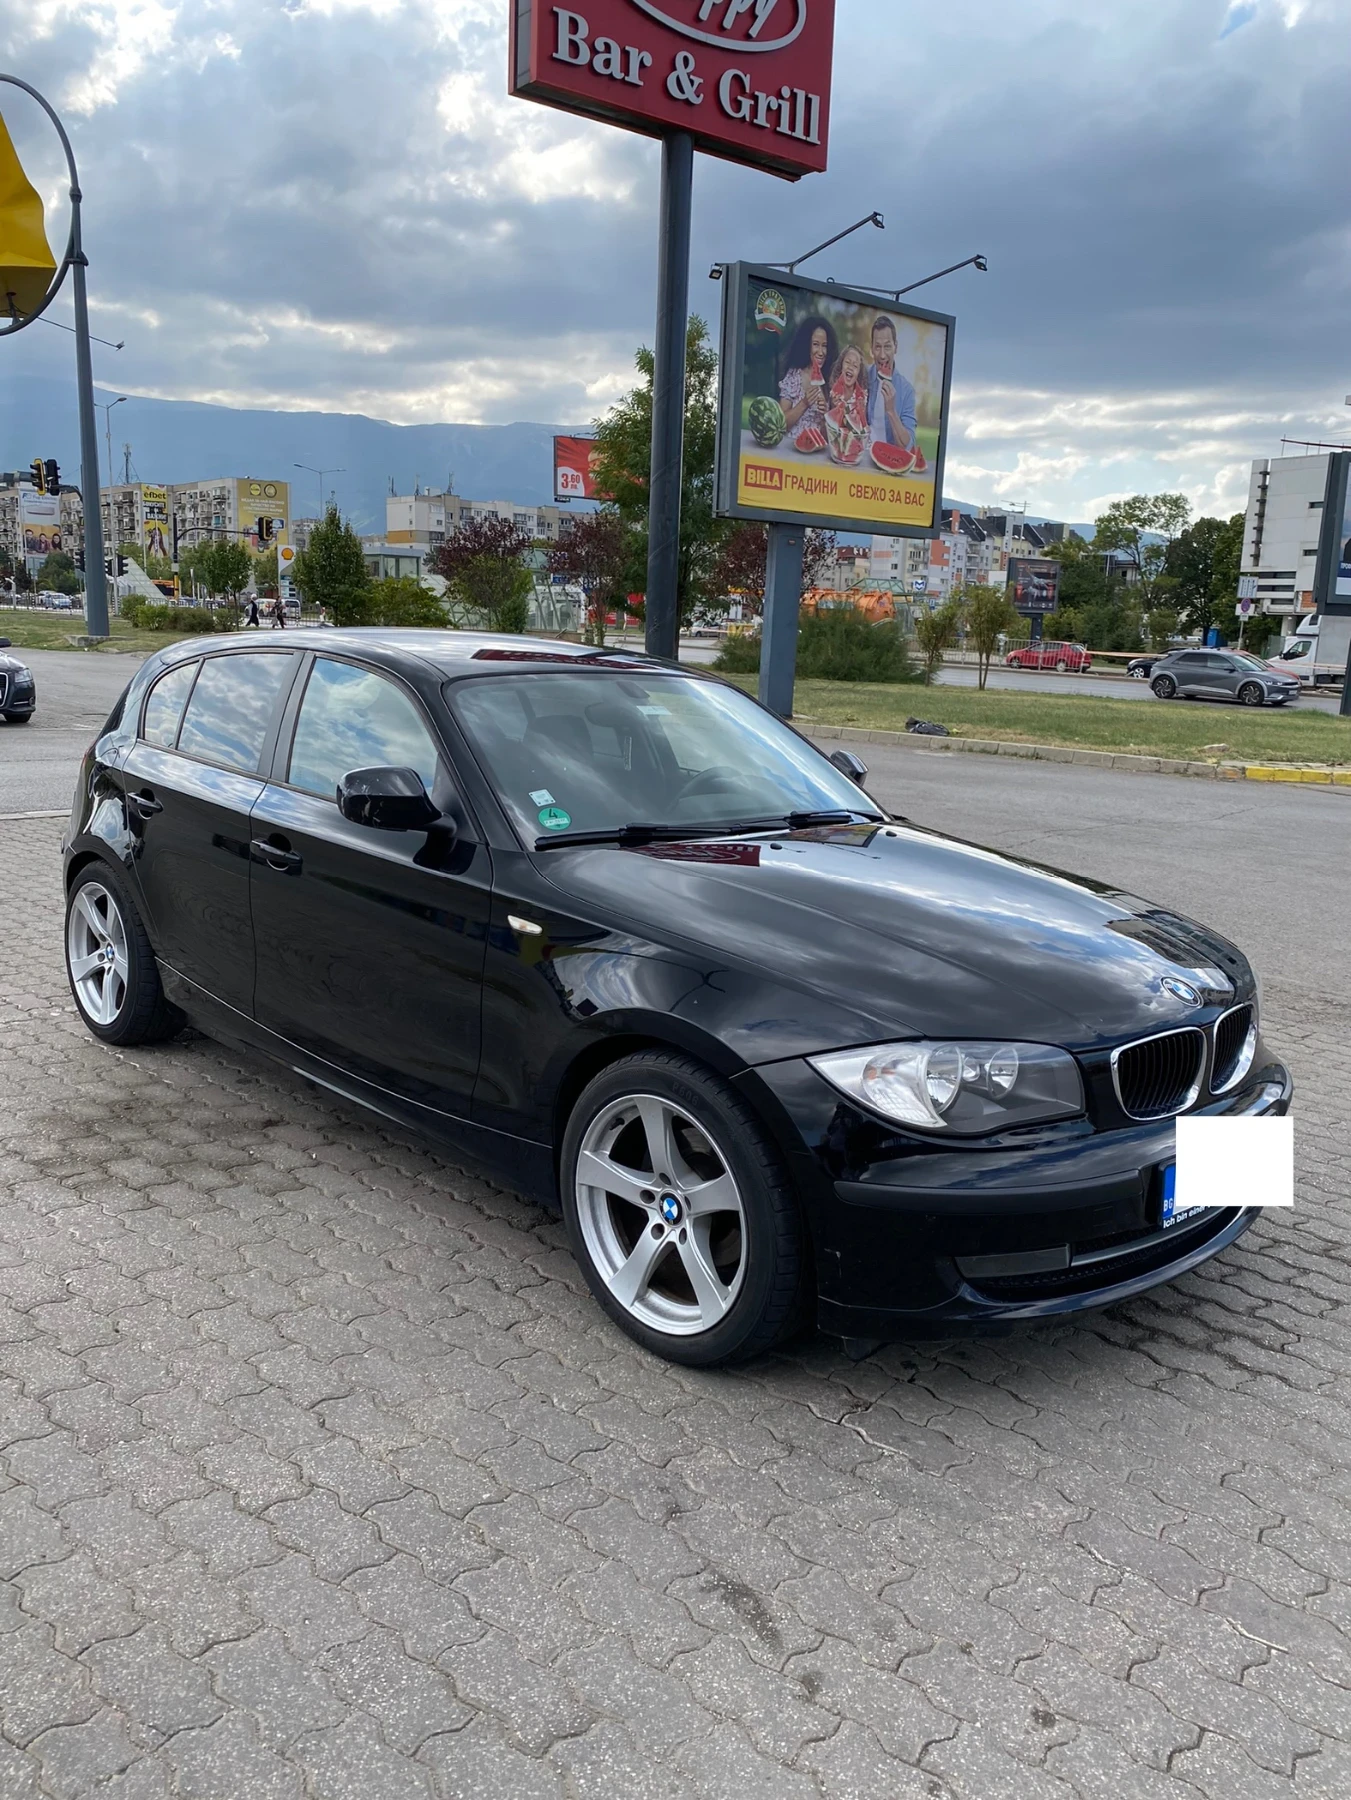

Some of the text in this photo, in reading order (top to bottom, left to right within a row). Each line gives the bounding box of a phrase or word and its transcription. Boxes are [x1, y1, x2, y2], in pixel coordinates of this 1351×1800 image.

[553, 6, 652, 87] Bar
[667, 51, 704, 105] &
[719, 69, 821, 145] Grill
[747, 468, 925, 507] BILLA ГРАДИНИ СВЕЖО ЗА ВАС
[548, 808, 558, 819] 4
[1163, 1198, 1173, 1212] BG
[1163, 1217, 1176, 1228] Ich
[1176, 1212, 1188, 1223] bin
